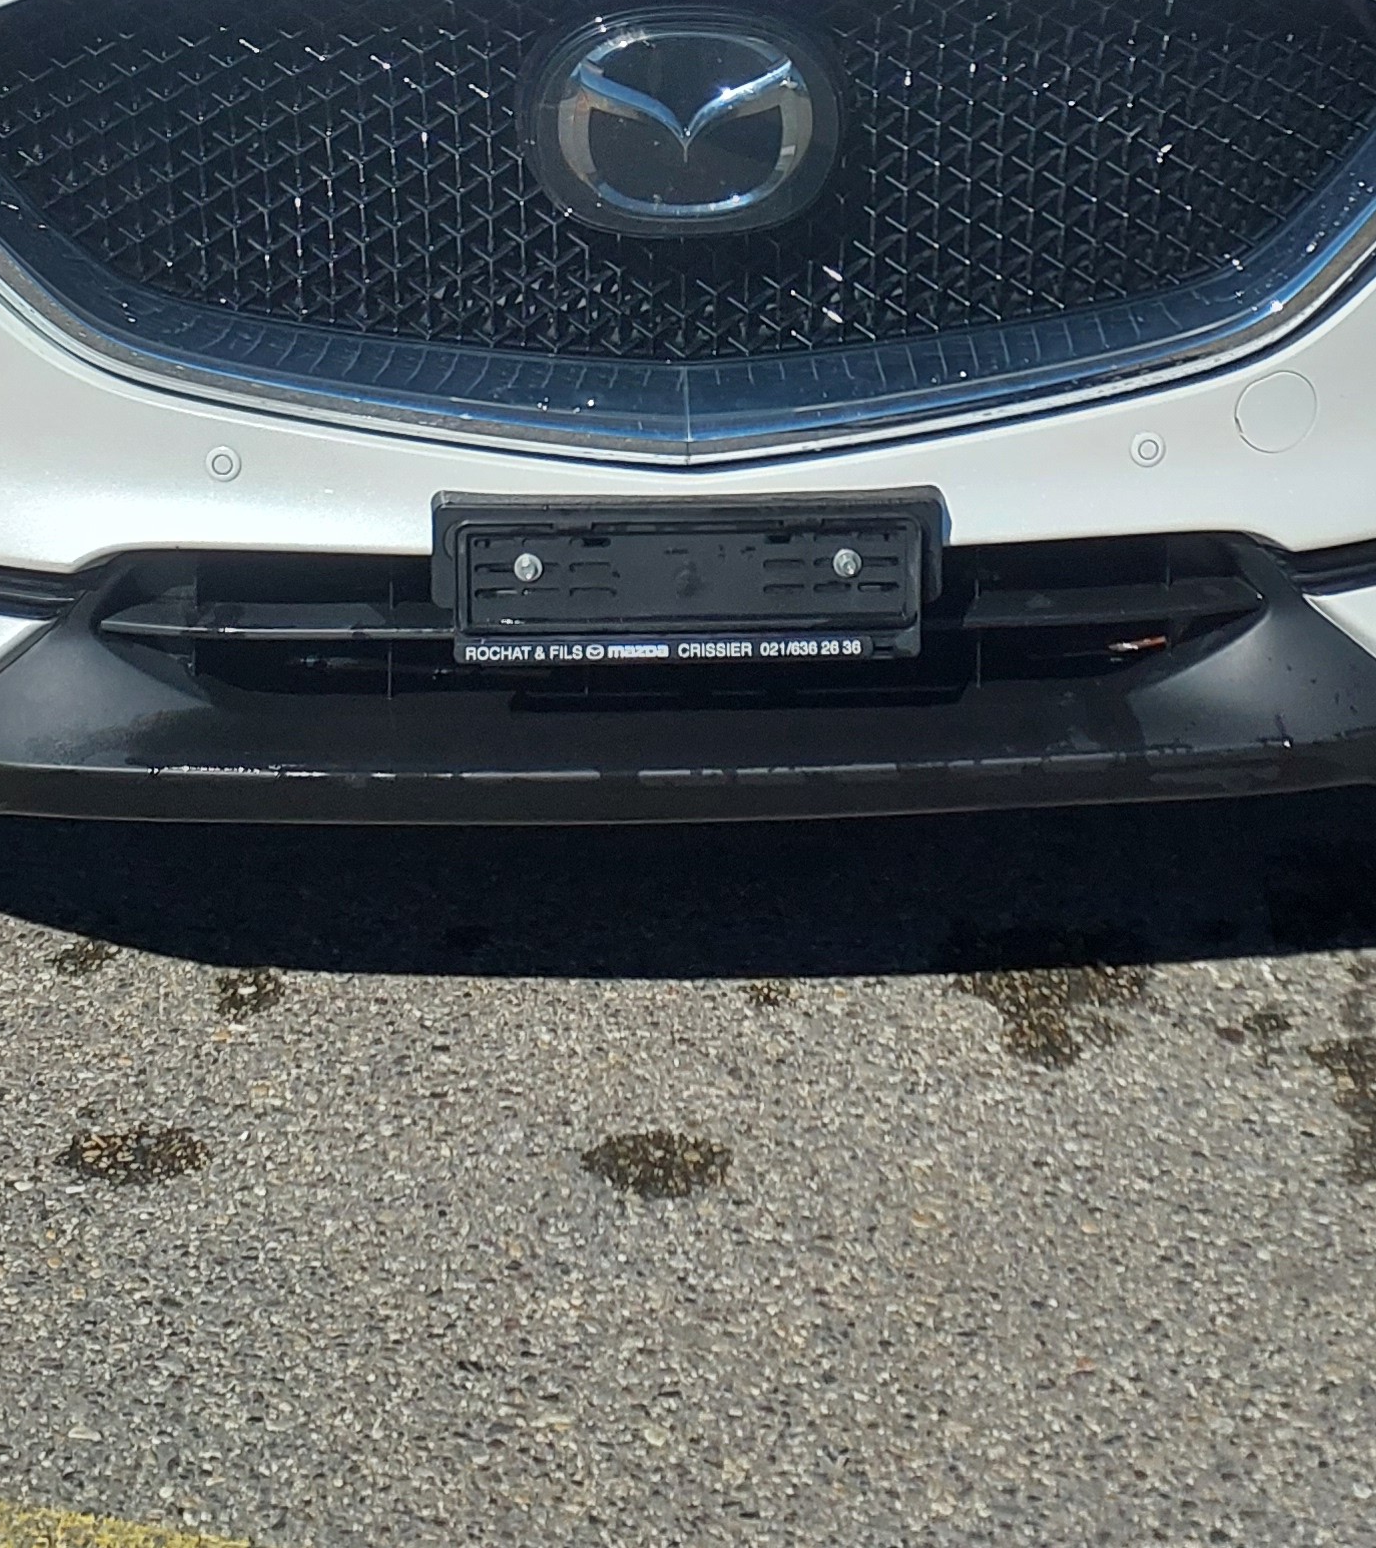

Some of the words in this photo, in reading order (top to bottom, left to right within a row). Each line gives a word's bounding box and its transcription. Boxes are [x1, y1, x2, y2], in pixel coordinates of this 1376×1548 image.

[465, 646, 531, 660] ROCHAT
[535, 645, 545, 660] &
[550, 645, 583, 659] FILS
[678, 642, 752, 658] CRISSIER
